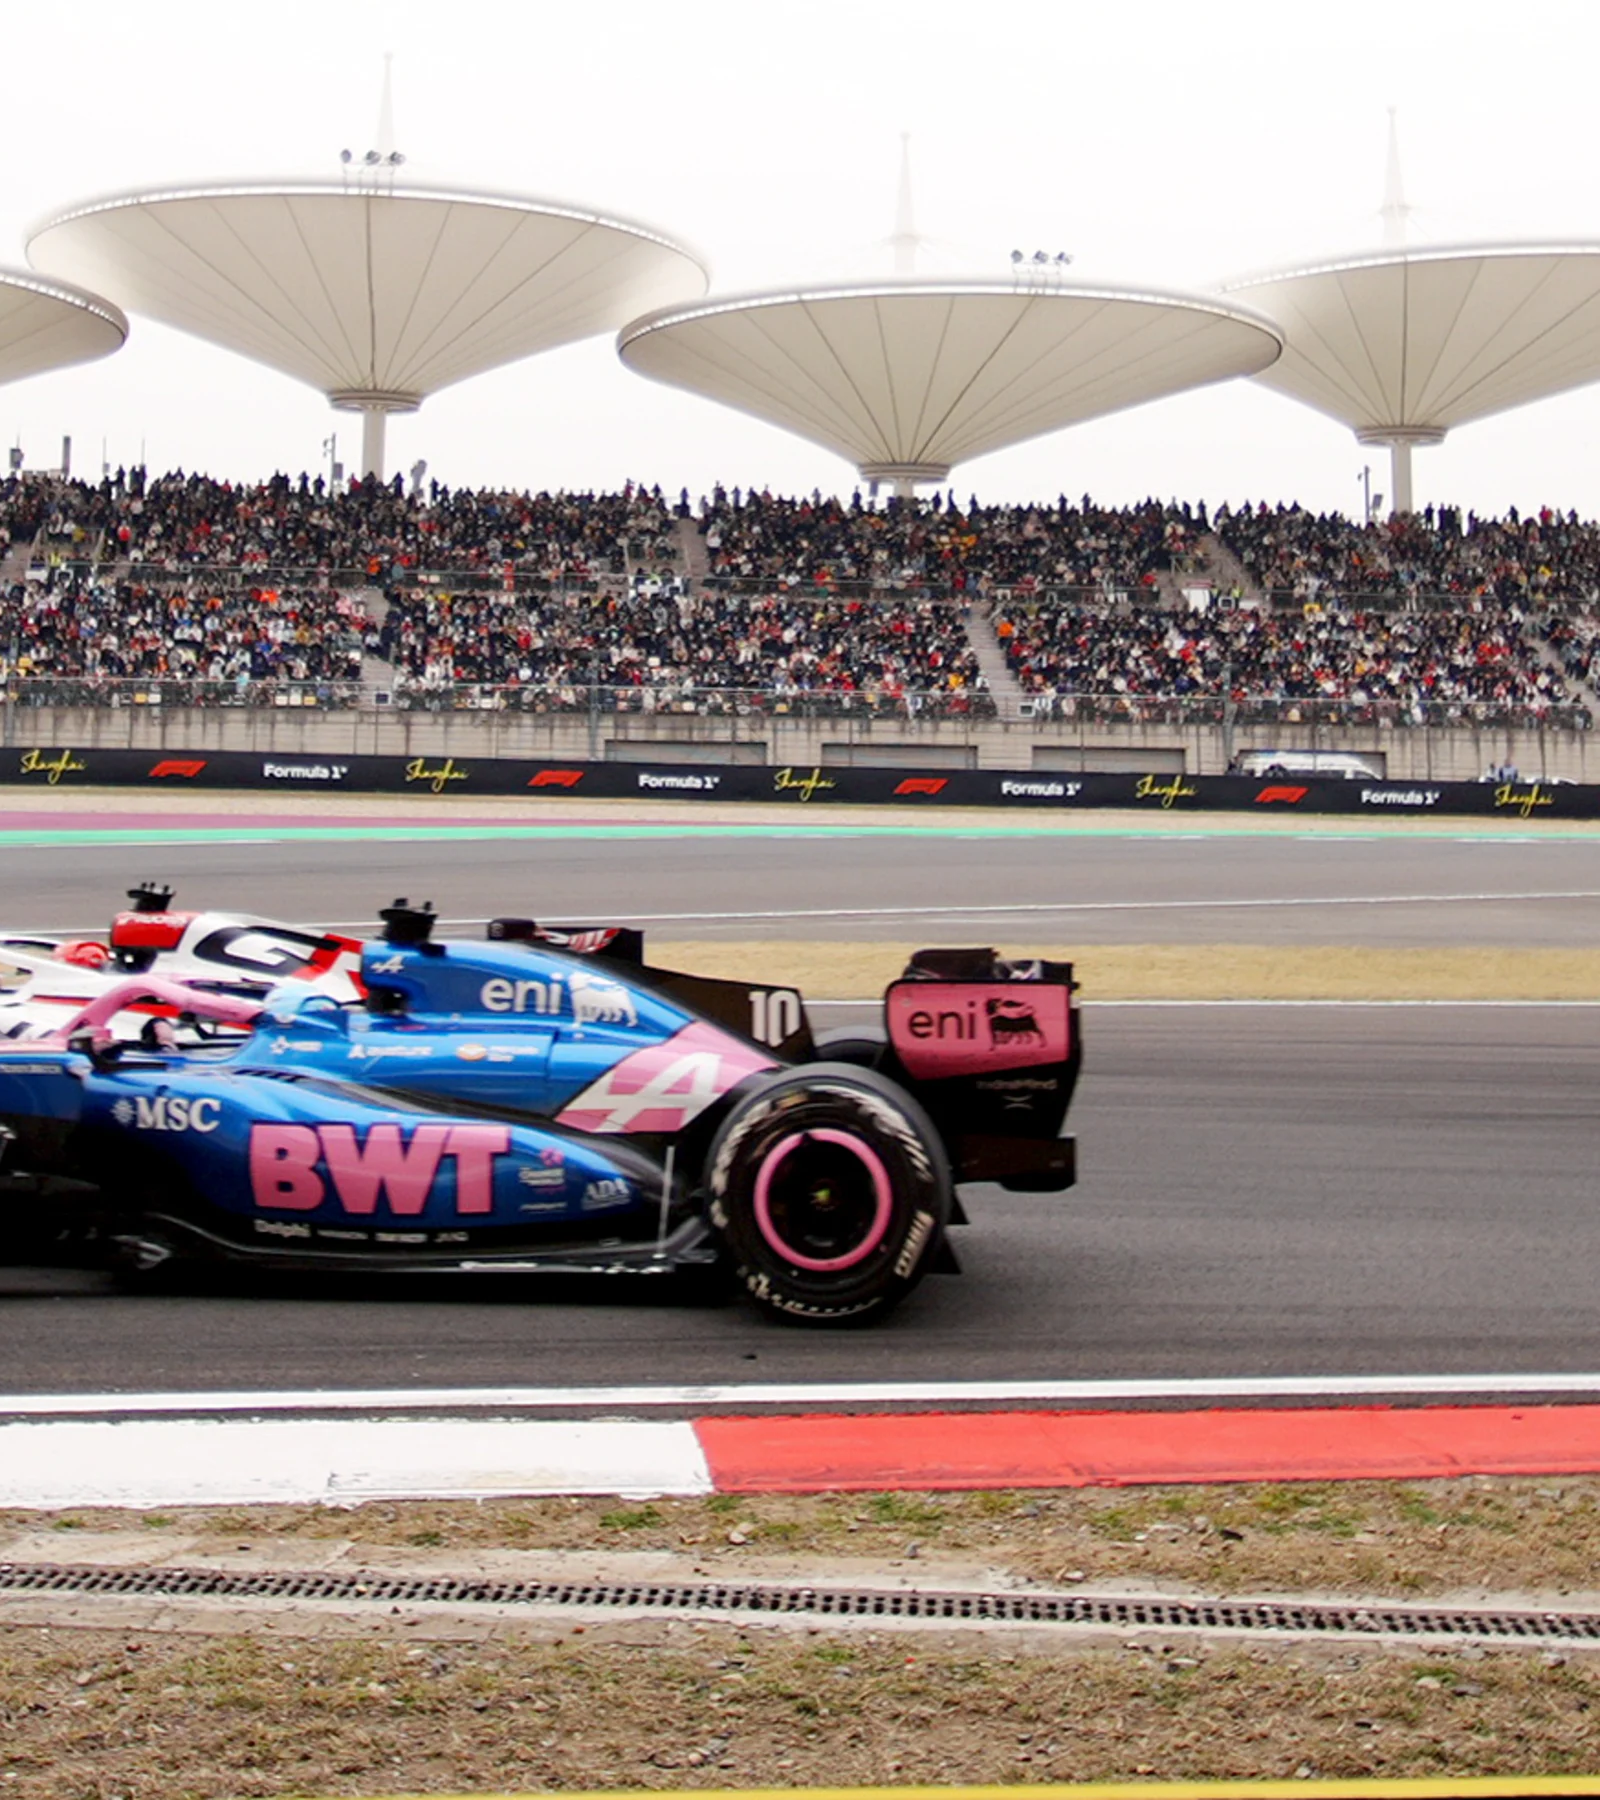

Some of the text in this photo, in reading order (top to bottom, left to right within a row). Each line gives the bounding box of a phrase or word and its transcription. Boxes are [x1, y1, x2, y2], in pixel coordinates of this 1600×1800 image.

[264, 763, 329, 779] Formula
[639, 774, 702, 789] Formula
[1002, 782, 1064, 797] Formula
[1361, 789, 1423, 805] Formula
[481, 973, 563, 1015] eni
[748, 990, 800, 1048] 10
[908, 1001, 977, 1041] eni
[135, 1097, 221, 1132] MSC
[250, 1122, 510, 1215] BWT
